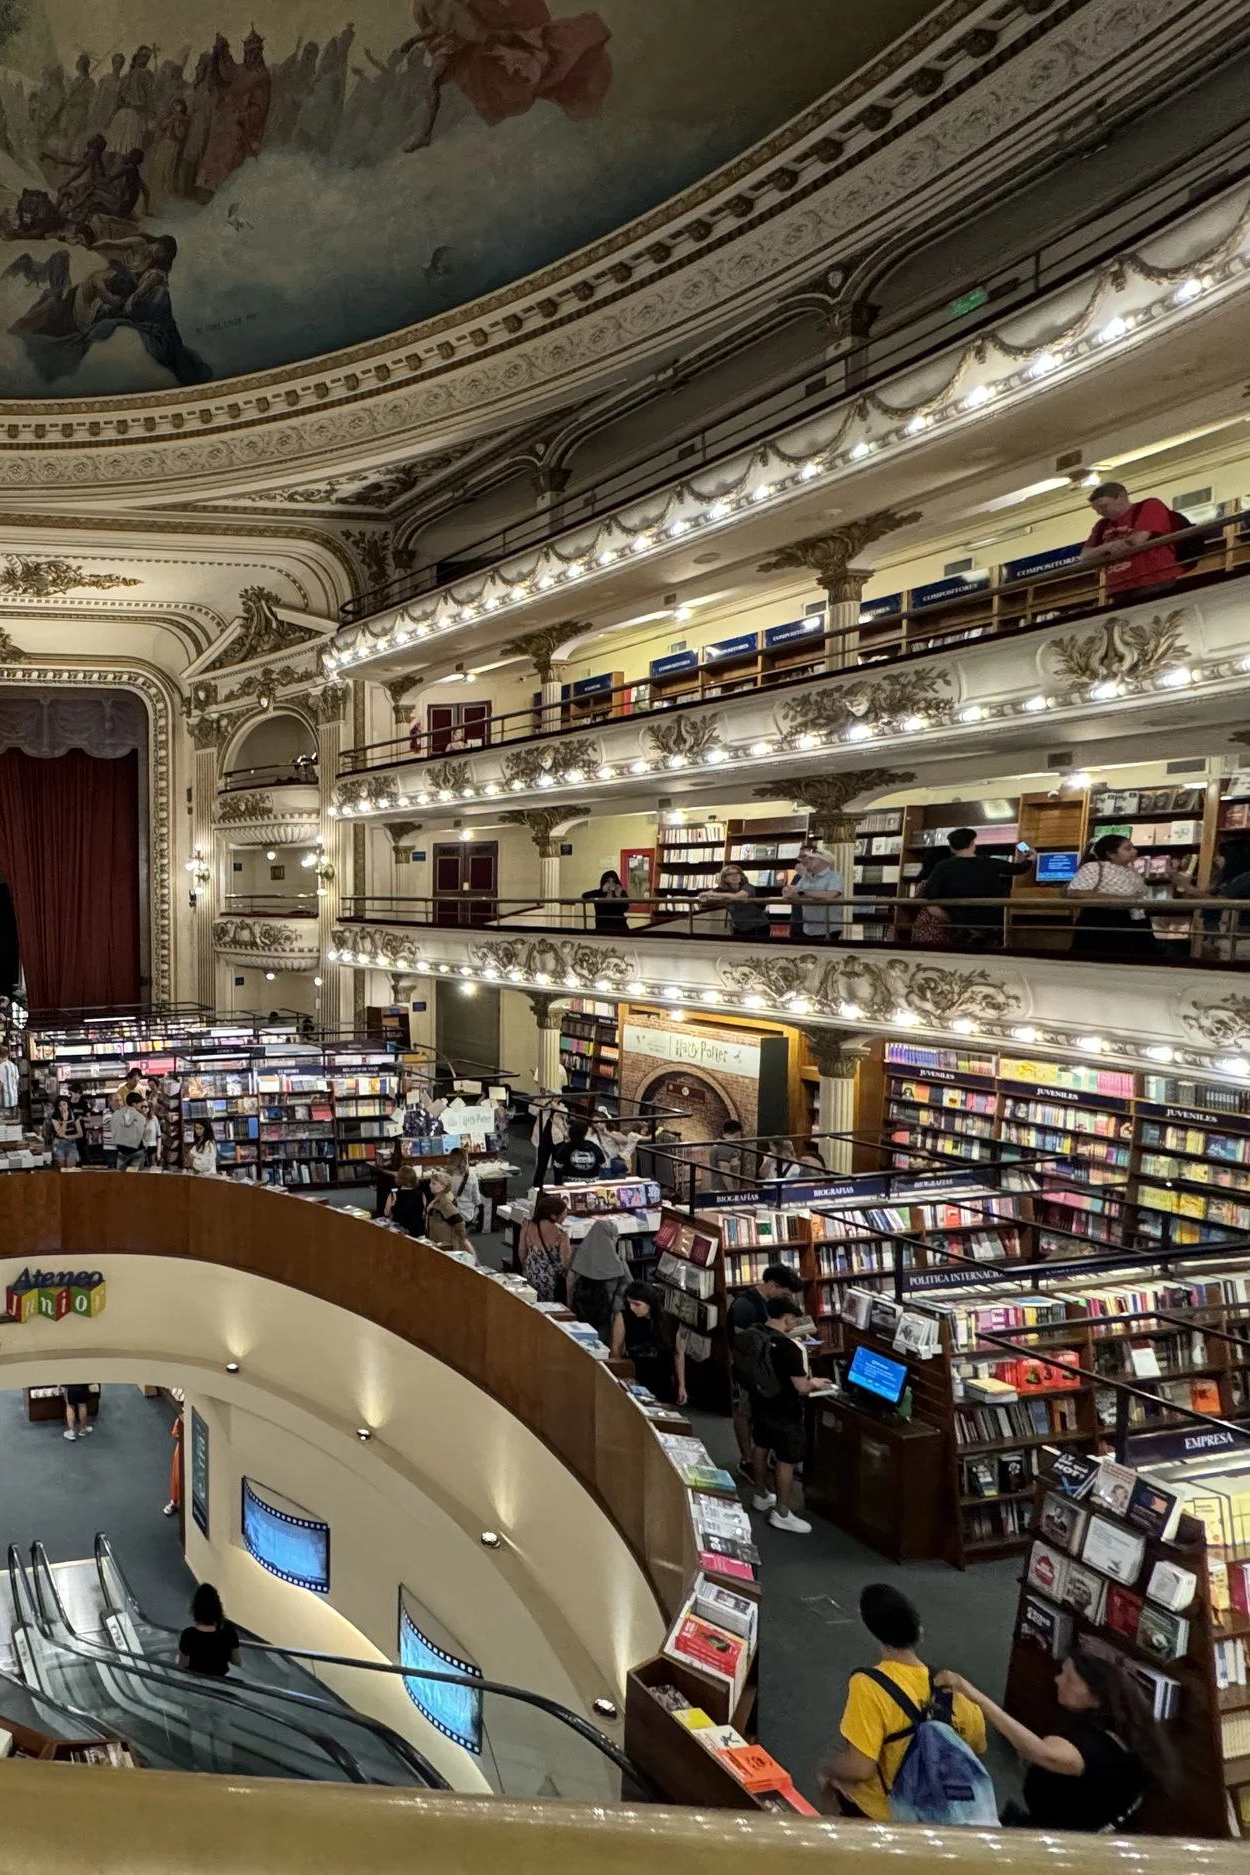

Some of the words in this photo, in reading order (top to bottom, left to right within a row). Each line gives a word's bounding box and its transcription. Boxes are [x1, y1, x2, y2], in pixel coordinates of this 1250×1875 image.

[1017, 555, 1083, 577] COMPOSITORES
[675, 1039, 700, 1059] Harry
[700, 1040, 728, 1062] Potter
[919, 1068, 956, 1081] JUVENILES
[1036, 1087, 1079, 1101] JUVENILES
[1166, 1107, 1218, 1124] JUVENILES
[716, 1192, 759, 1204] BIOGRAFÍAS
[12, 1267, 106, 1290] Ateneo
[1184, 1431, 1235, 1450] EMPRESA
